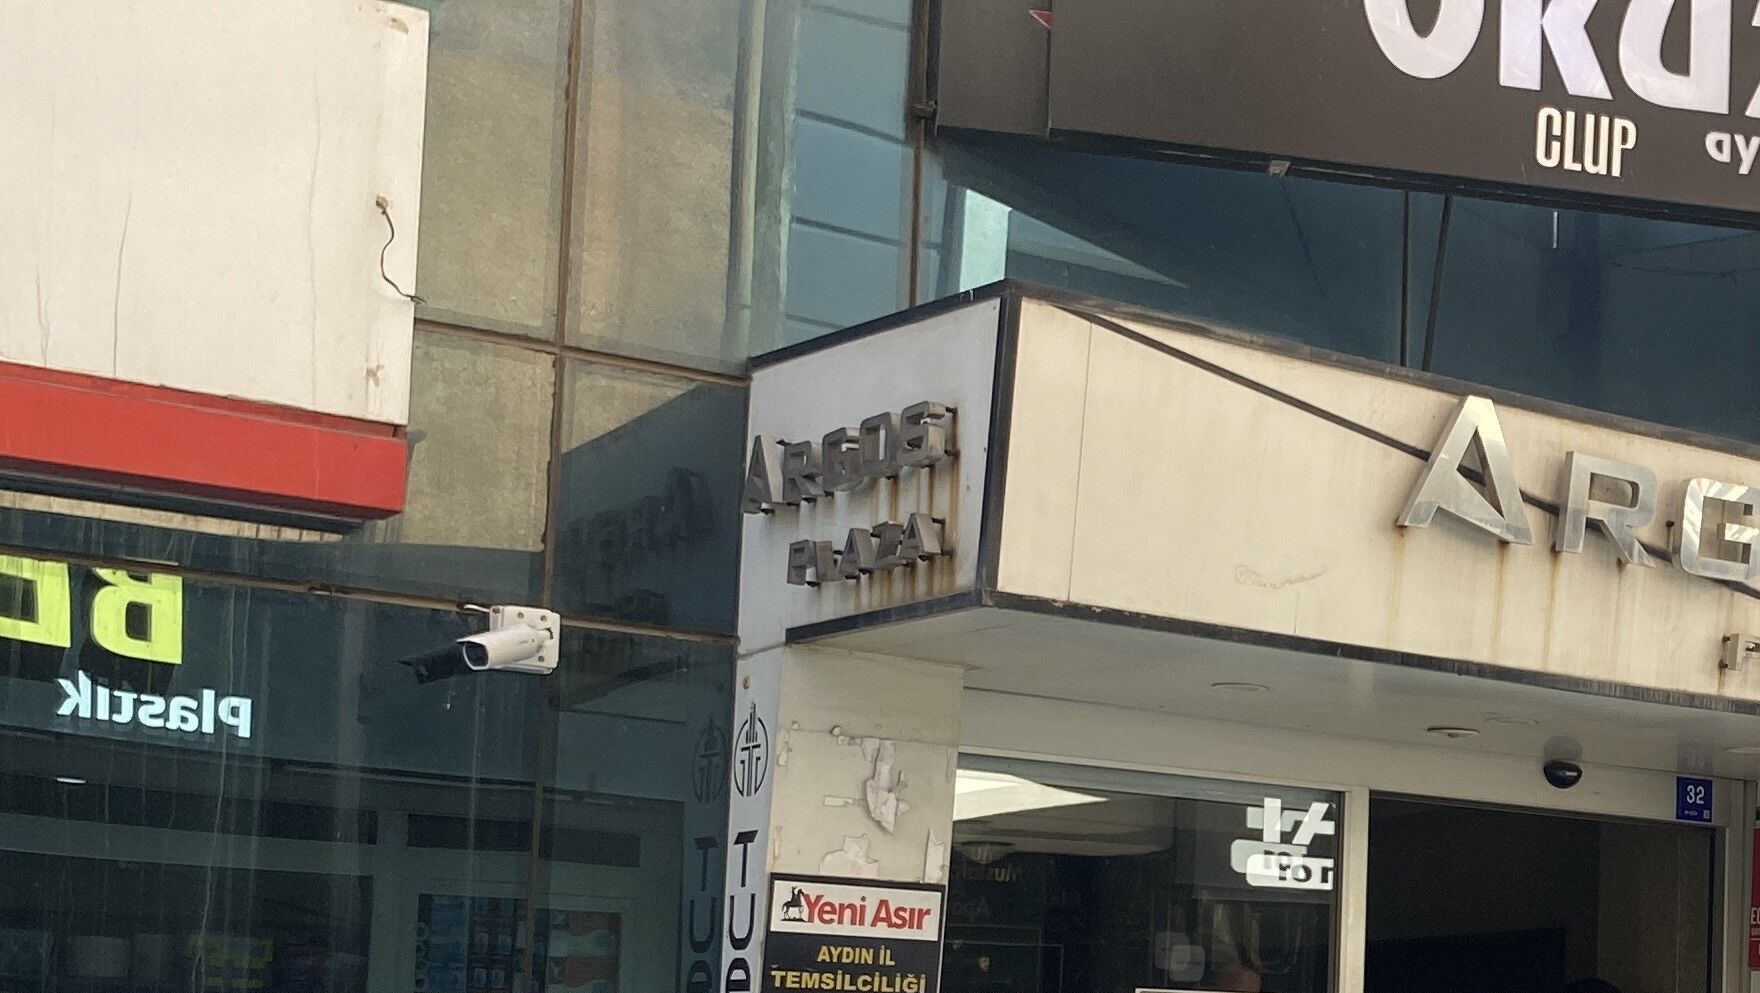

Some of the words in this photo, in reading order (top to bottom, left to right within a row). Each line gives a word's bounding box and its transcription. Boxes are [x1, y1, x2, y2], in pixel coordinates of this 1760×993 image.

[1536, 106, 1638, 178] CLUP
[1686, 785, 1705, 804] 32
[803, 893, 866, 927] Yeni
[871, 899, 931, 930] Asır
[817, 945, 874, 966] AYDIN
[879, 945, 895, 966] İL
[770, 970, 927, 993] TEMSİLCİLİĞİ
